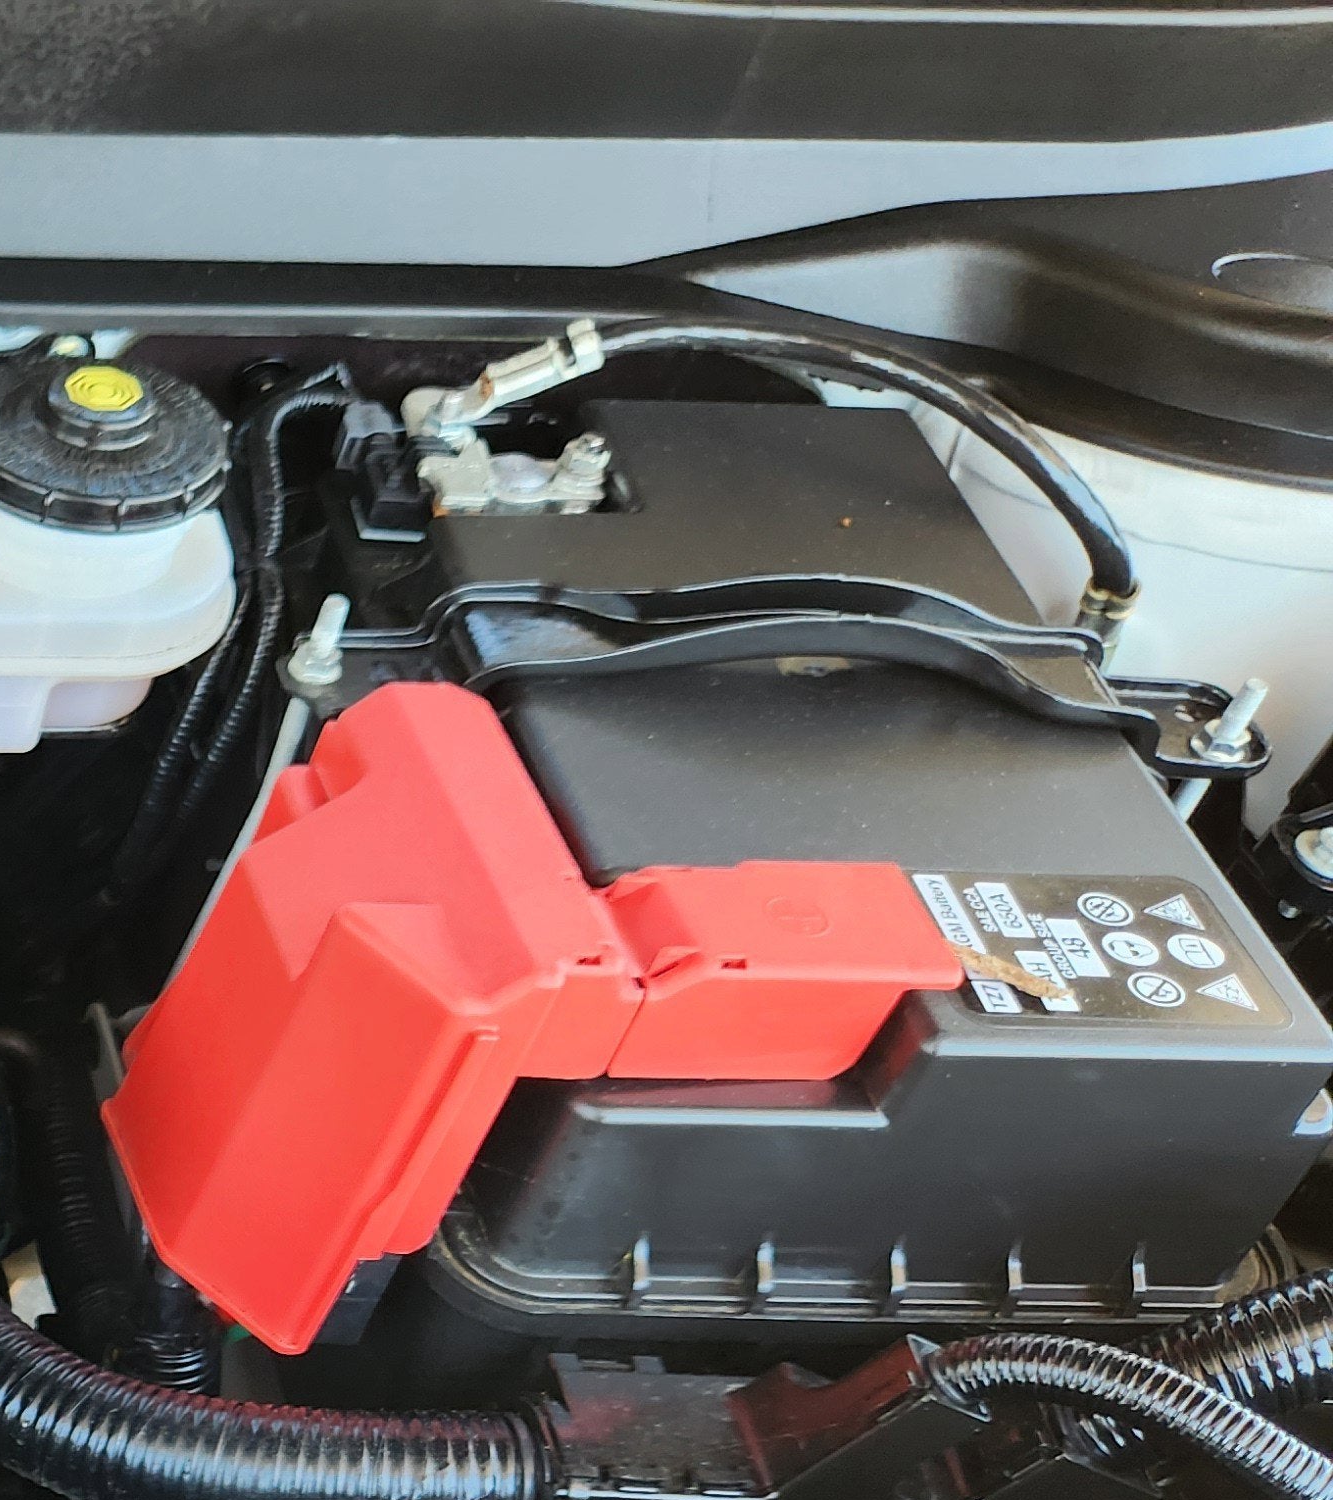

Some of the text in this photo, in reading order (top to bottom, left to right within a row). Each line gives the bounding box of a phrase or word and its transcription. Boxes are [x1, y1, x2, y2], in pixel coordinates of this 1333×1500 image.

[926, 876, 958, 923] Battery
[988, 893, 1023, 930] 650A
[1027, 912, 1077, 980] GROUP SIZE
[1061, 937, 1091, 959] 48
